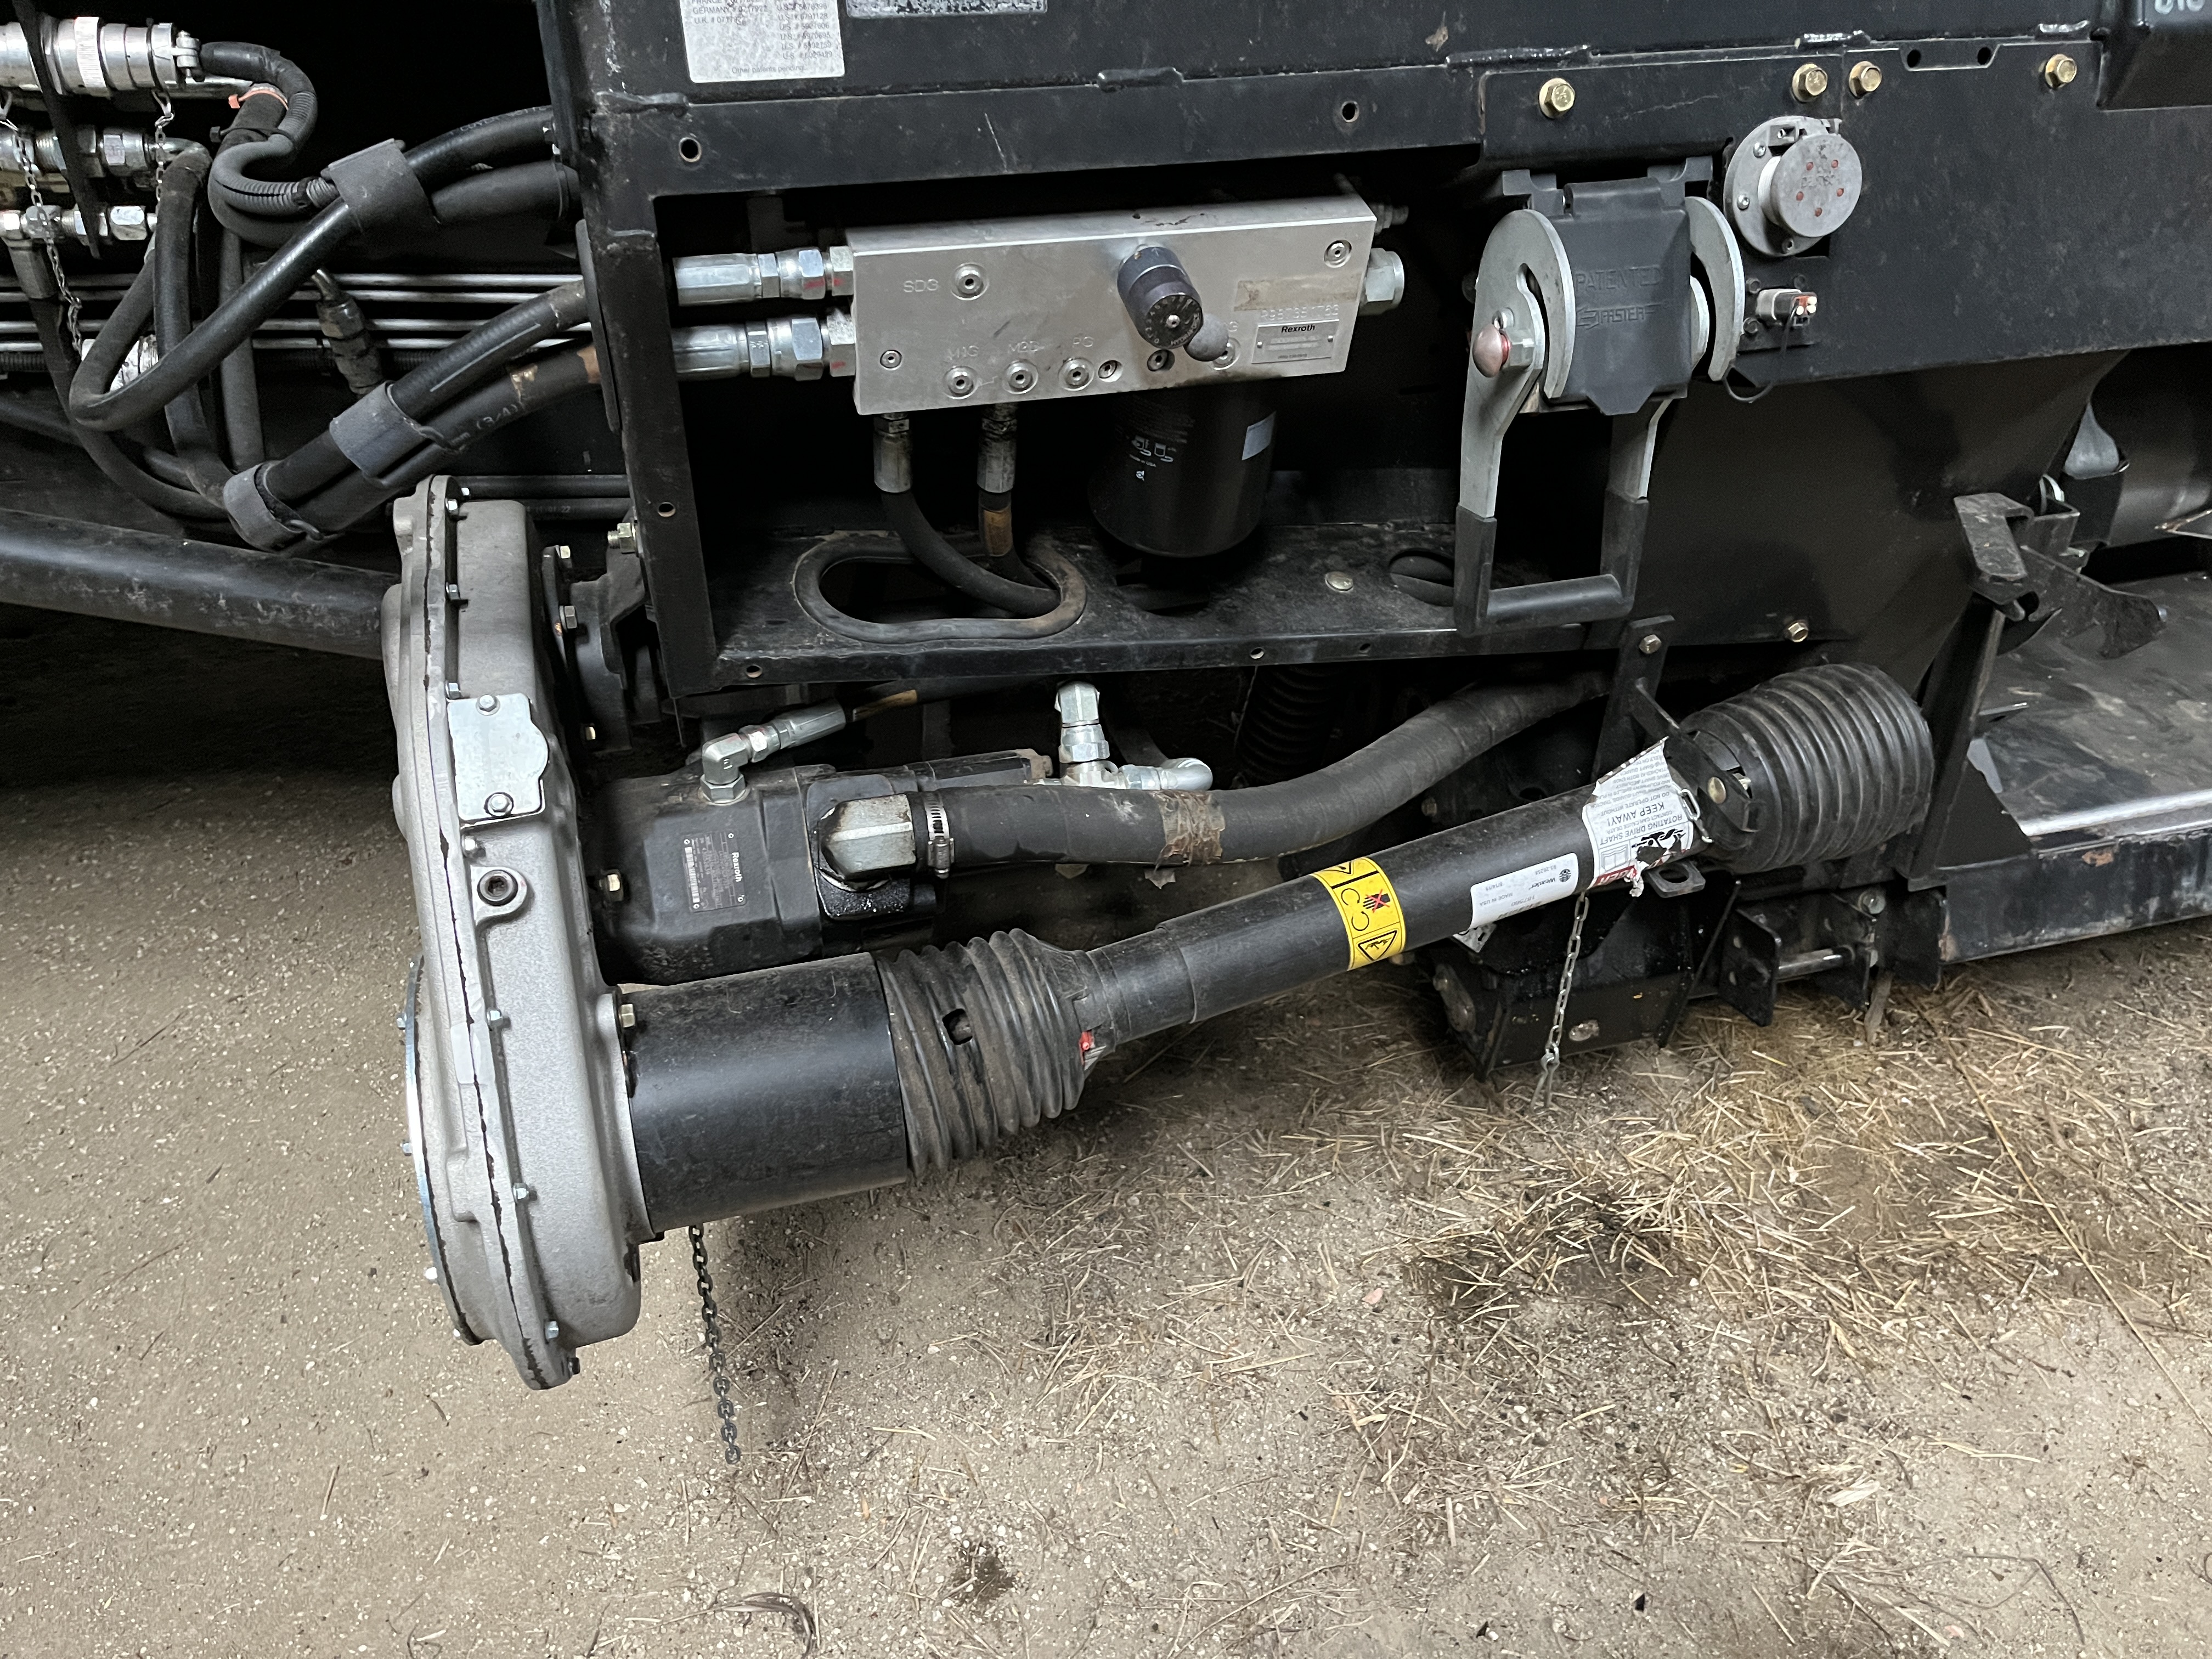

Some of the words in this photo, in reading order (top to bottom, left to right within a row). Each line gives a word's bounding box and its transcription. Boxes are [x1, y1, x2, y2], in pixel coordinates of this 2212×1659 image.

[1575, 264, 1662, 292] PATENTED
[903, 279, 939, 293] SDG
[1281, 324, 1316, 334] Rexroth
[1626, 798, 1649, 809] OPERATE
[1639, 802, 1665, 817] KEEP
[1607, 810, 1638, 827] AWAY!
[1651, 810, 1673, 821] CONTACT
[1647, 814, 1683, 831] ROTATING
[1624, 825, 1646, 838] DRIVE
[1599, 832, 1624, 845] SHAFT
[731, 851, 743, 882] Rexroth
[1497, 892, 1514, 901] MADE
